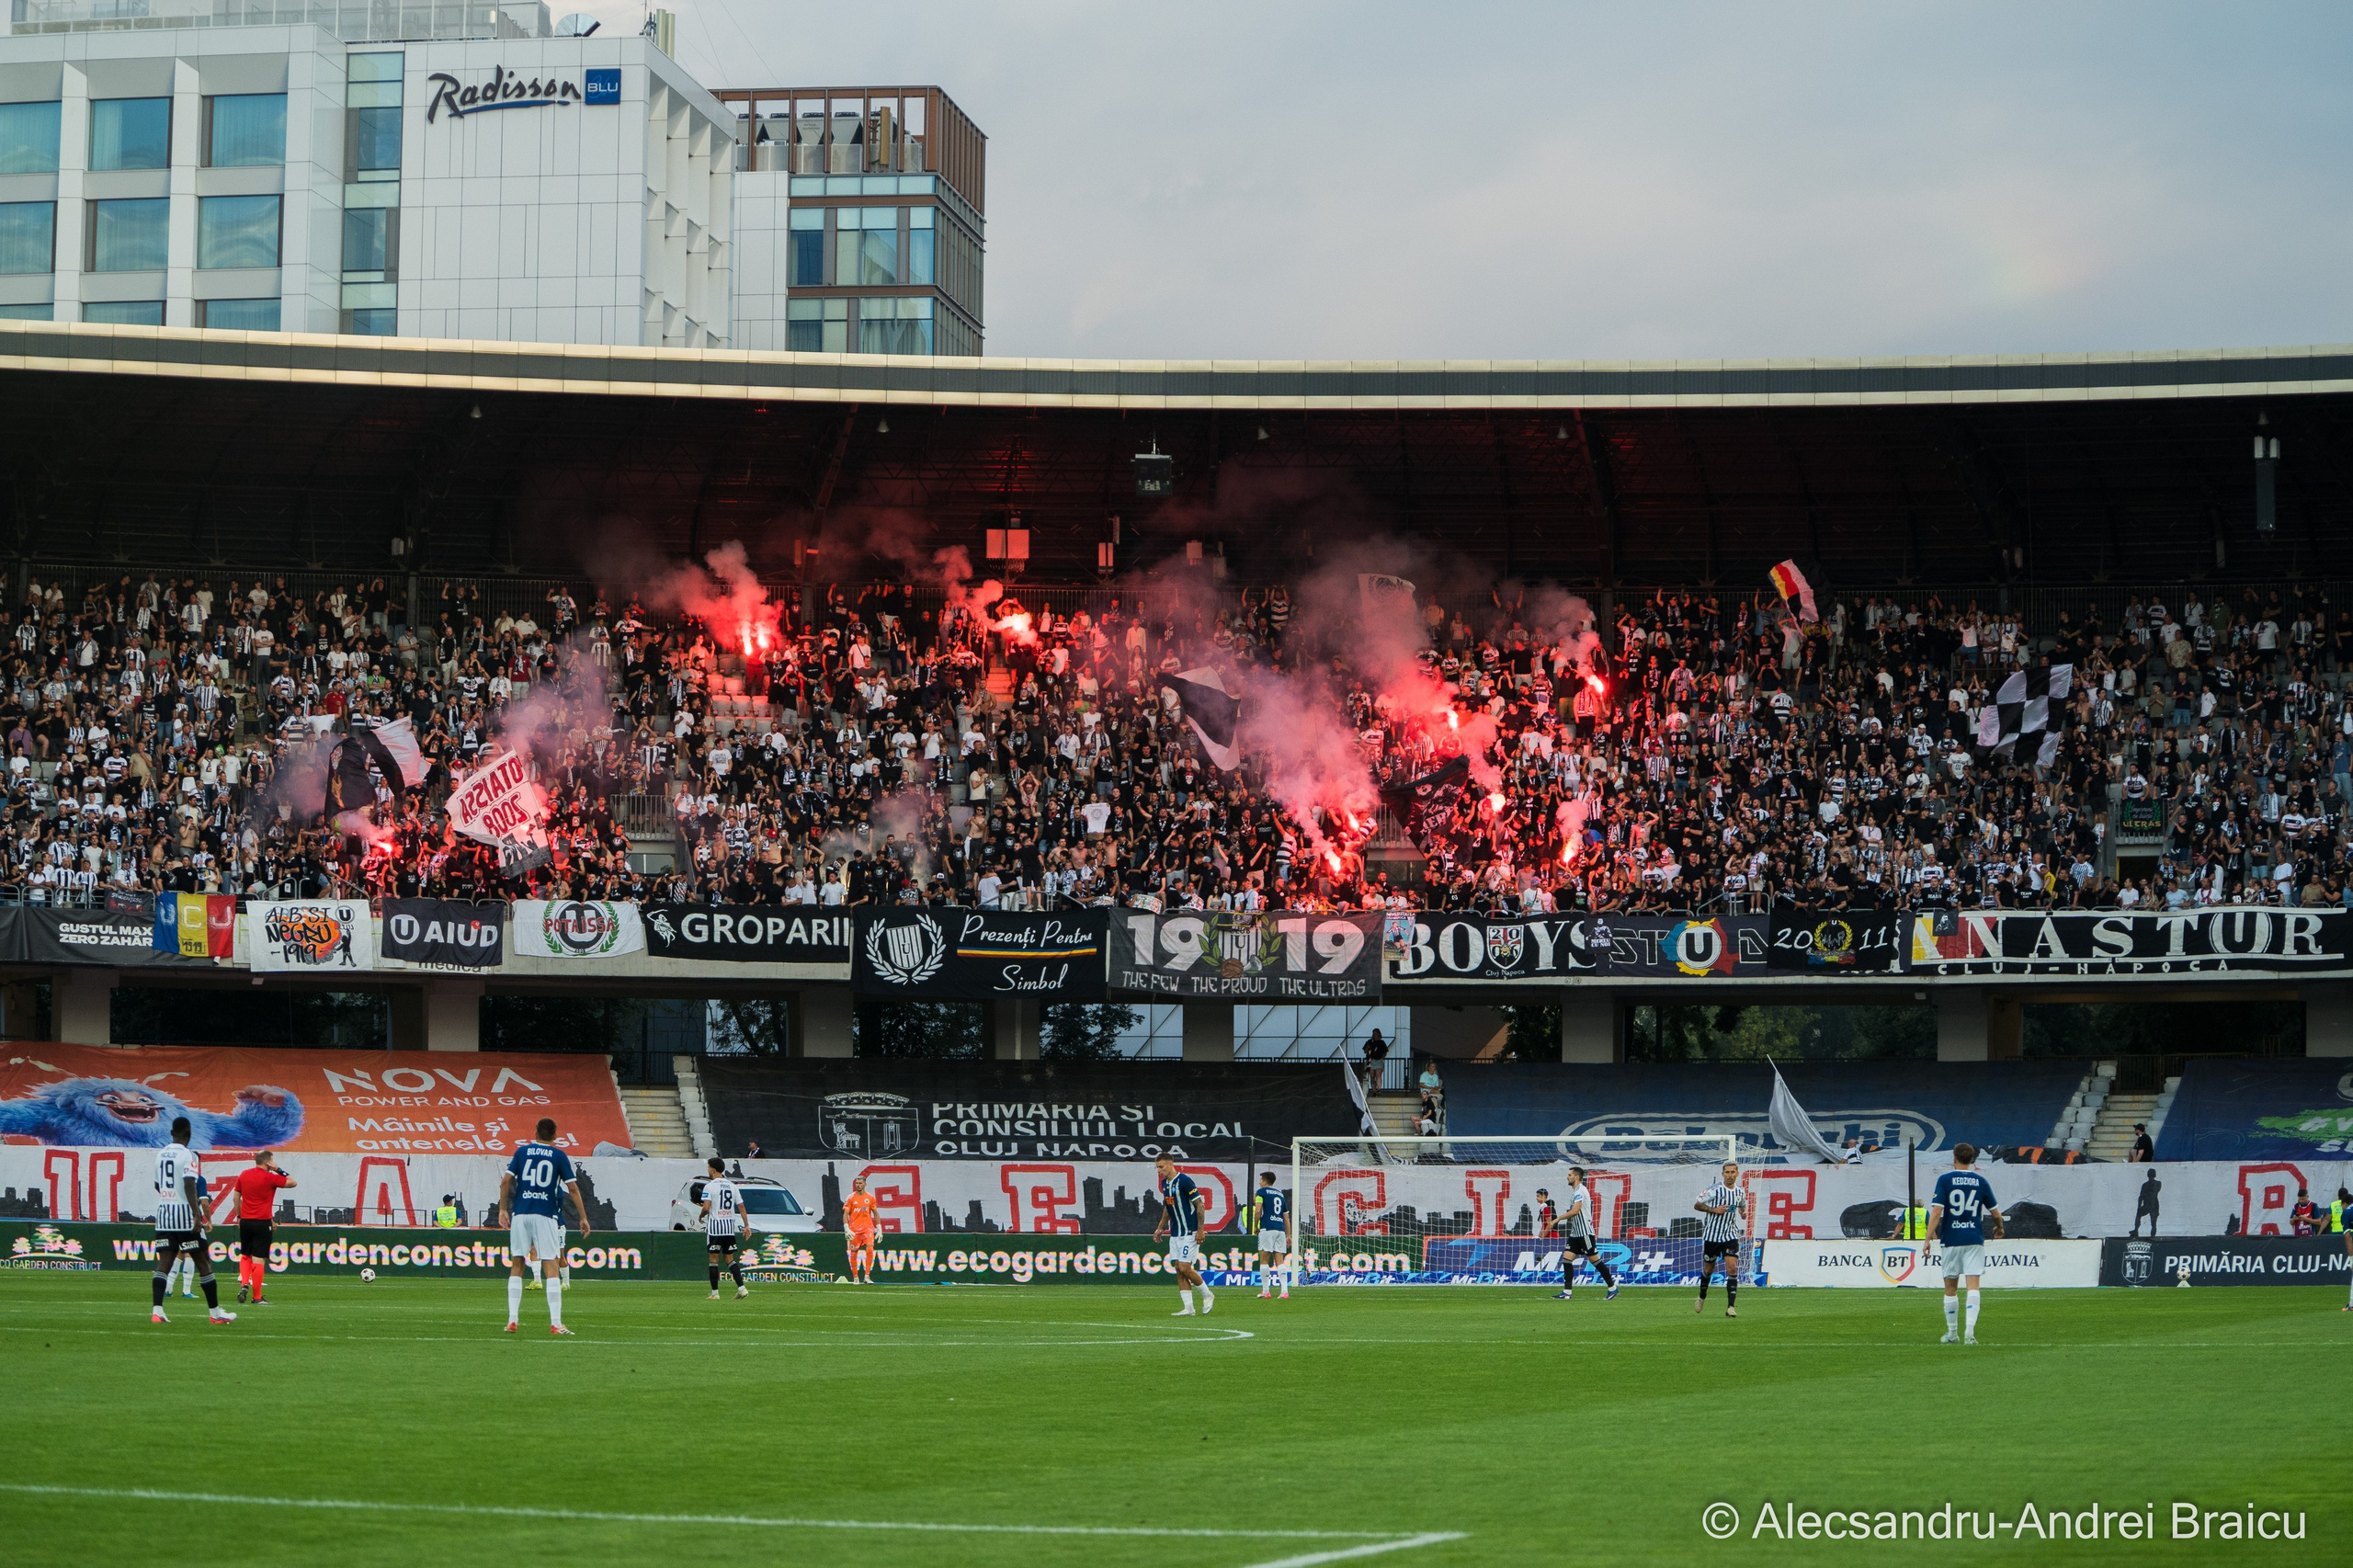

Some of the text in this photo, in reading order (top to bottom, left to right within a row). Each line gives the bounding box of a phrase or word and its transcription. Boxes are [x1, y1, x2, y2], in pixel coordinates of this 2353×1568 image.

[427, 64, 619, 124] Radisson BLU
[265, 906, 300, 923] ALB
[59, 923, 153, 937] GUSTUL MAX
[424, 920, 498, 948] AIUD
[680, 913, 850, 947] GROPARII
[59, 934, 153, 947] ZERO ZAHĂR
[1127, 915, 1366, 974] 19 19
[994, 963, 1069, 991] Simbol
[1485, 968, 1526, 977] Cluj Napoca
[1122, 971, 1366, 996] THE FEW THE PROUD THE ULTRAS
[322, 1067, 544, 1093] NOVA
[337, 1095, 551, 1107] POWER AND GAS
[347, 1116, 510, 1138] Mâinile și
[933, 1119, 1253, 1139] CONSILIUL LOCAL
[356, 1132, 581, 1151] antenele ss!
[934, 1140, 1189, 1159] CLUJ NAPOCA
[527, 1147, 553, 1157] BILOVAR
[160, 1160, 175, 1188] 19
[522, 1158, 553, 1187] 40
[720, 1189, 733, 1210] 18
[1273, 1197, 1282, 1215] 8
[1949, 1188, 1980, 1217] 94
[1182, 1245, 1189, 1256] 6
[13, 1259, 49, 1269] GARDEN
[50, 1260, 102, 1270] CONSTRUCT
[1817, 1254, 2040, 1267] BANCA BT TRLVANIA
[2165, 1251, 2266, 1273] PRIMĂRIA
[741, 1272, 778, 1282] GARDEN
[779, 1272, 835, 1282] CONSTRUCT
[1337, 1271, 1395, 1285] MrBit
[1451, 1271, 1509, 1285] MrBit
